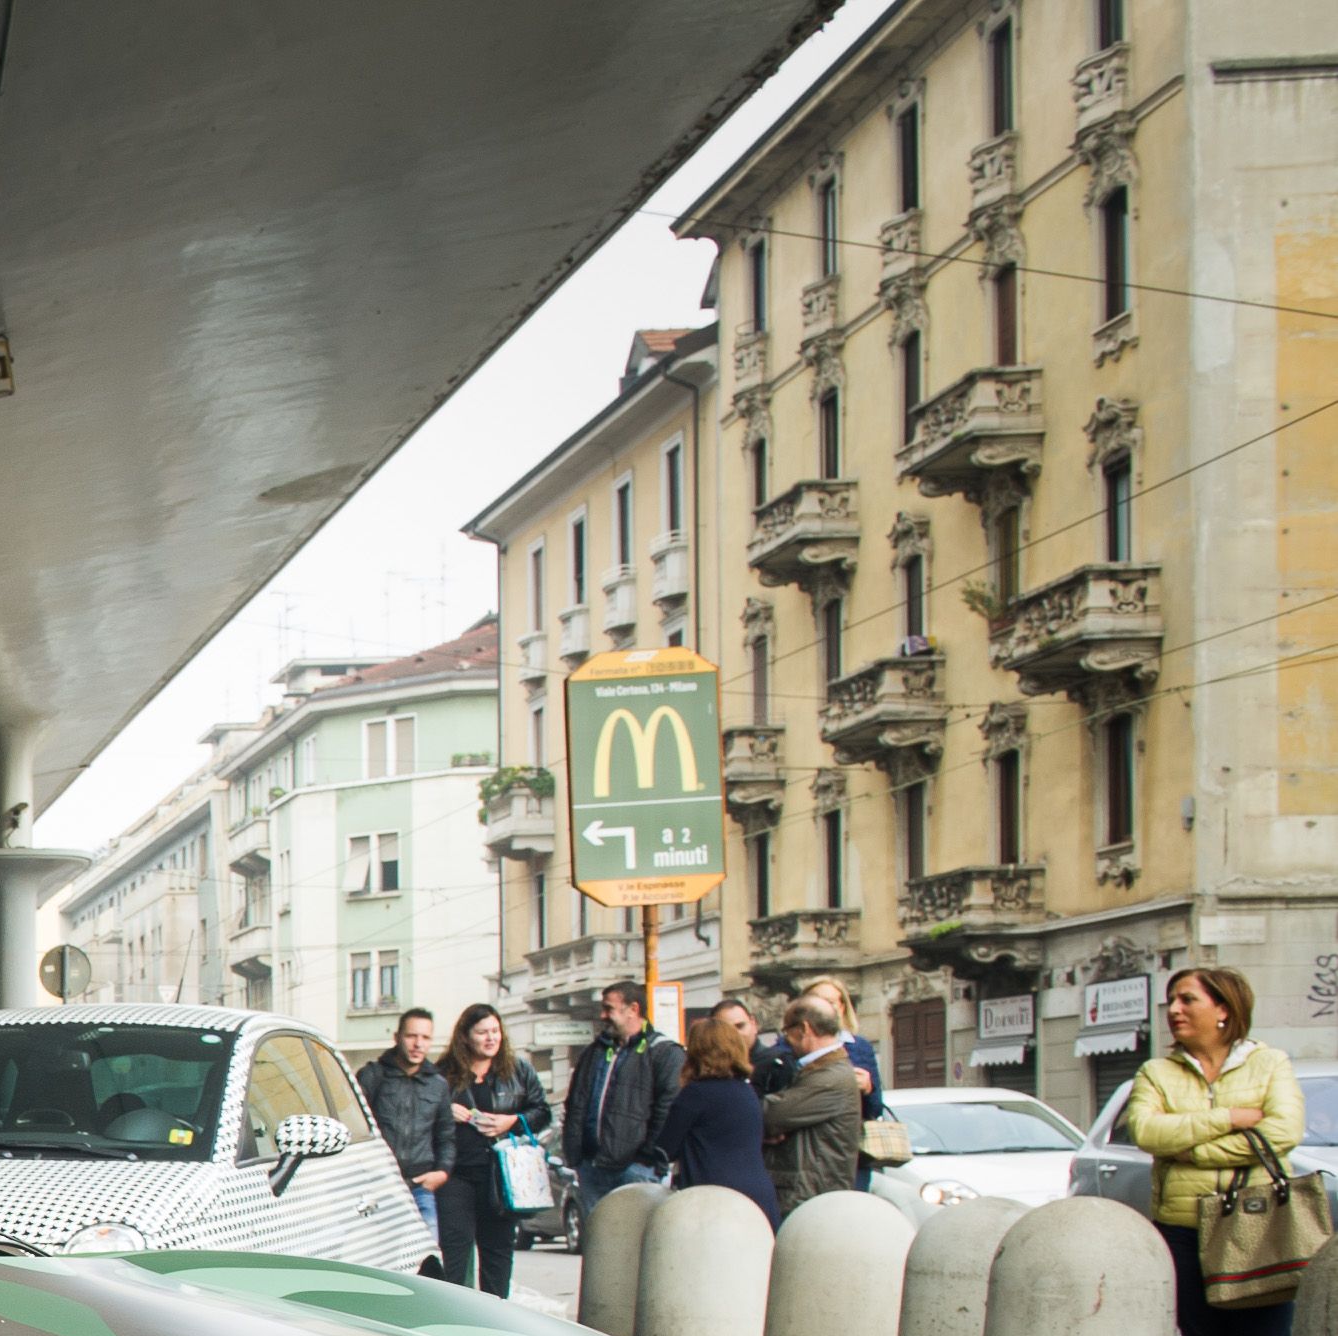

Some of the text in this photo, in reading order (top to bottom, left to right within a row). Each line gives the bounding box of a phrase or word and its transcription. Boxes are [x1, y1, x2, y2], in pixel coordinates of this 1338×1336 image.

[594, 686, 615, 698] Viale
[669, 681, 698, 693] Milano
[662, 827, 692, 844] a 2
[653, 844, 708, 868] minuti
